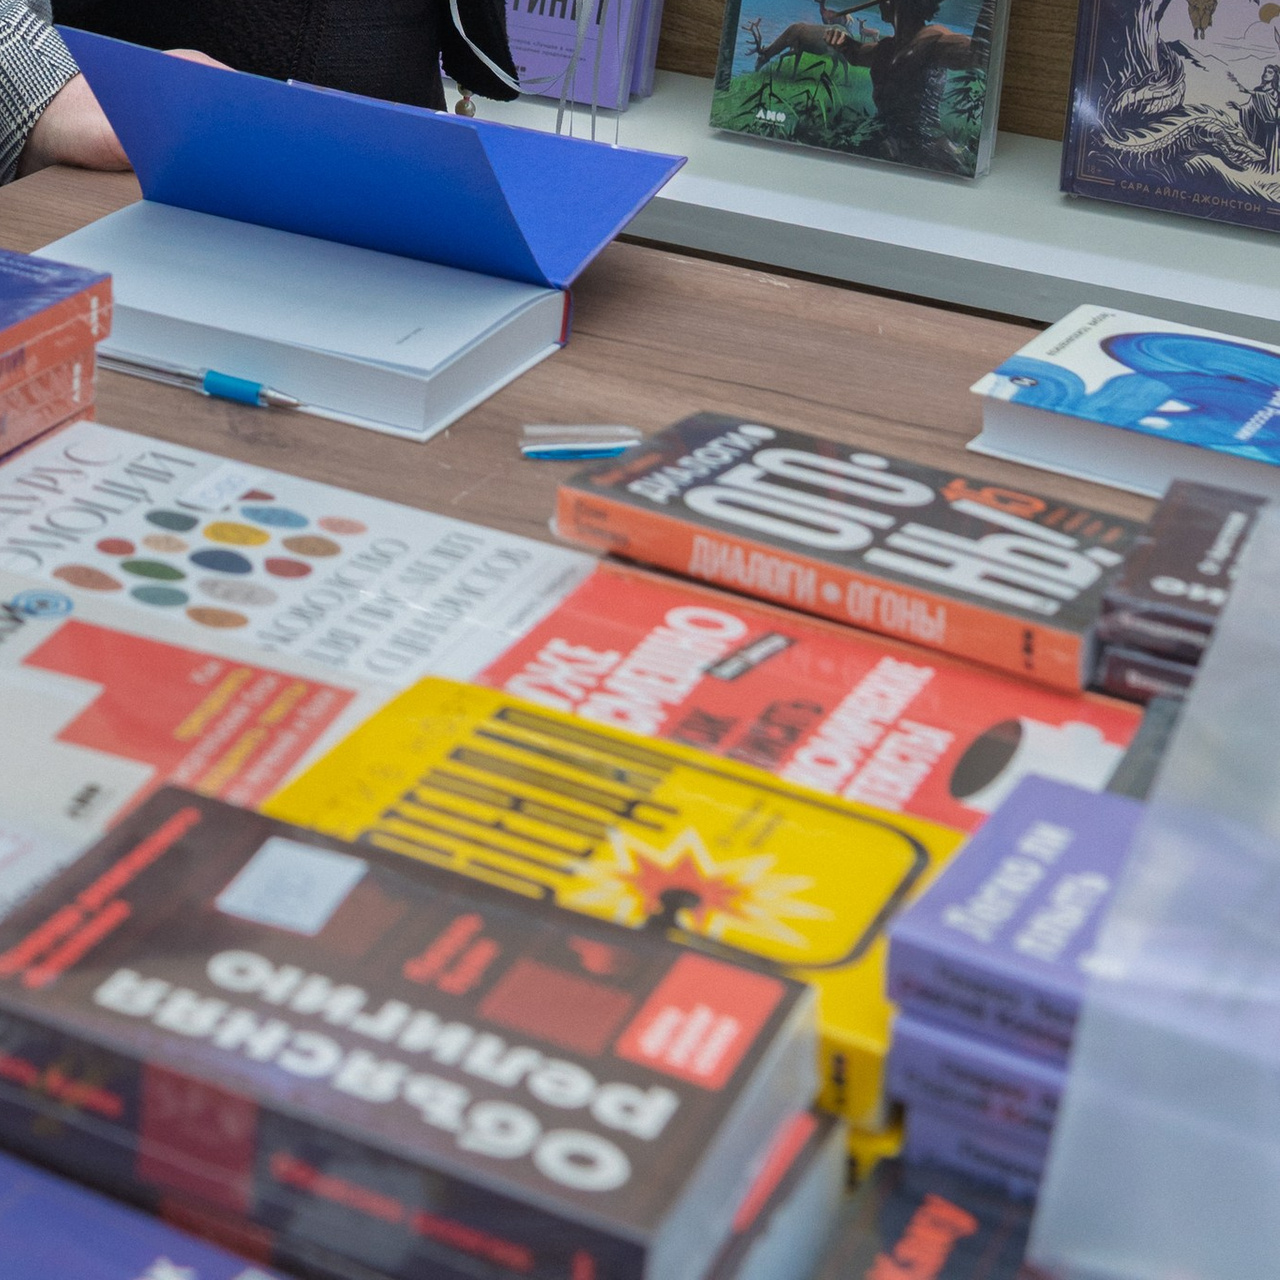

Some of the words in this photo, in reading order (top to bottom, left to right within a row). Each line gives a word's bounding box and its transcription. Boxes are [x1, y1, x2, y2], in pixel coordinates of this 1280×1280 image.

[1120, 179, 1151, 194] САРА
[1154, 183, 1263, 215] АЙЛС-ДЖОНСТОН
[626, 430, 760, 505] ДИАЛОГИ
[687, 534, 818, 607] ДИАЛОГИ
[93, 968, 632, 1193] Объясняя
[206, 948, 681, 1141] религию
